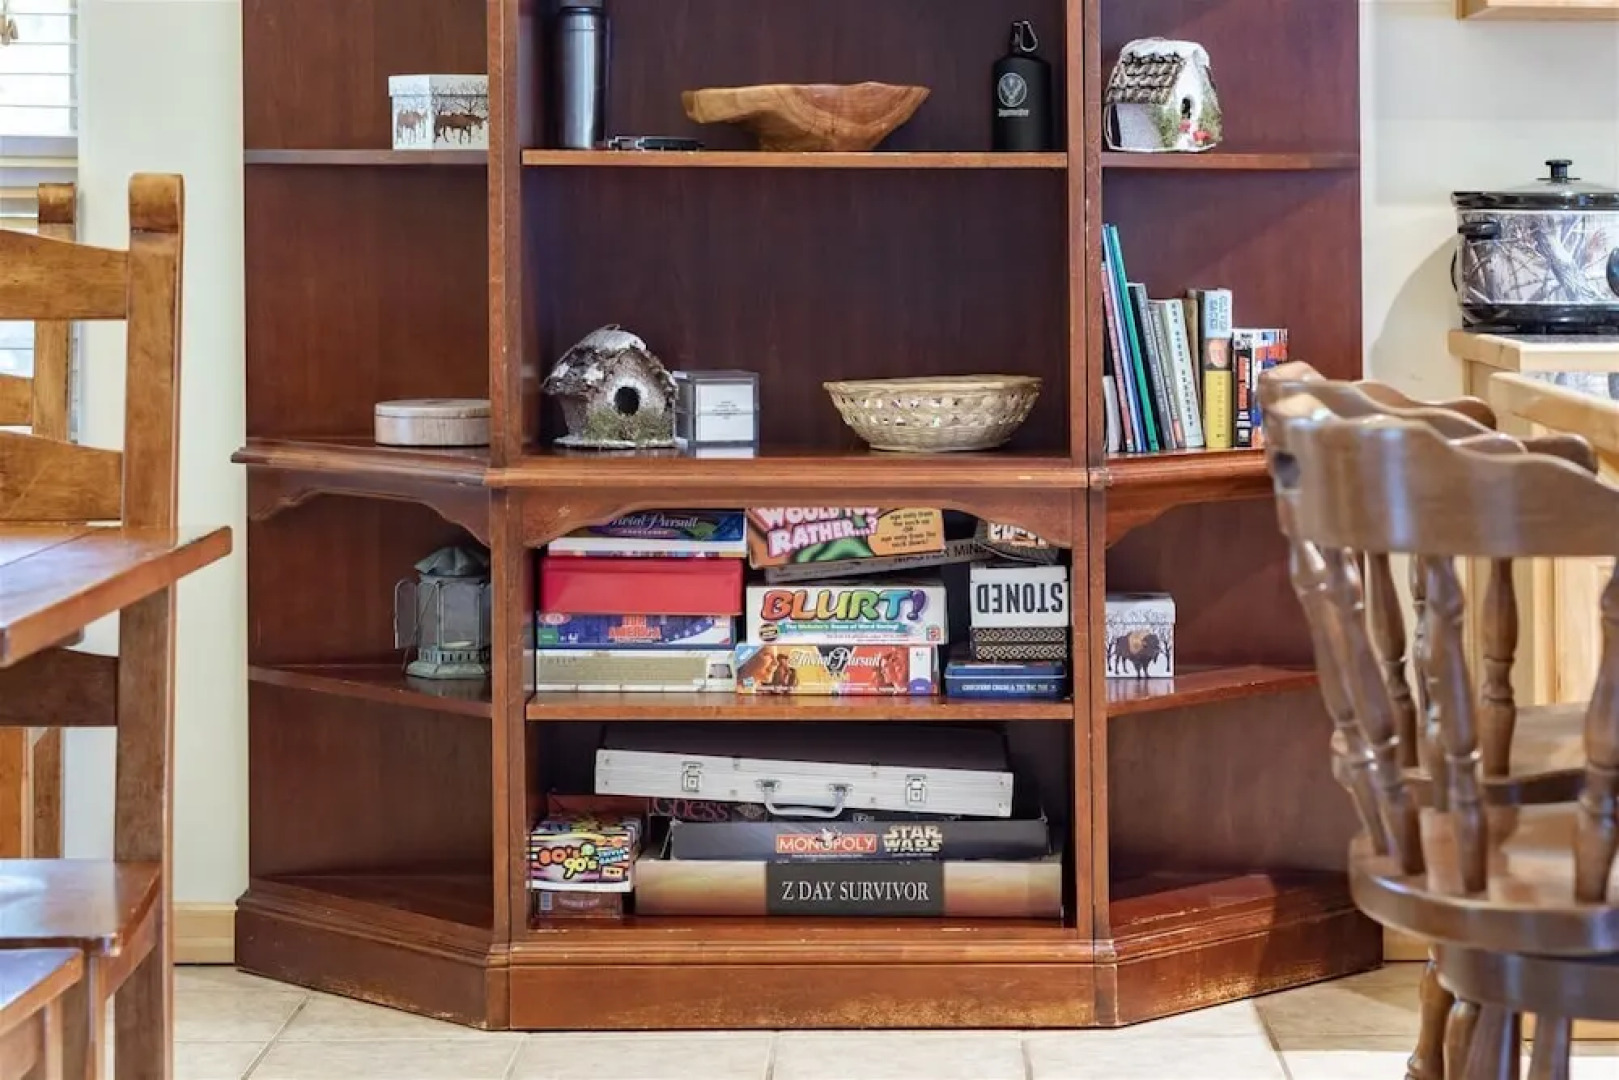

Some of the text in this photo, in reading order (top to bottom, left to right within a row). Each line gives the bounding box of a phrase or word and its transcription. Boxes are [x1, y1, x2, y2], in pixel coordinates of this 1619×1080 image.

[761, 589, 928, 622] BLURT!
[977, 584, 1063, 613] STONED
[882, 825, 942, 839] STAR
[779, 836, 876, 852] MONOPOLY
[883, 838, 942, 852] WARS
[781, 881, 930, 901] Z DAY SURVIVOR
